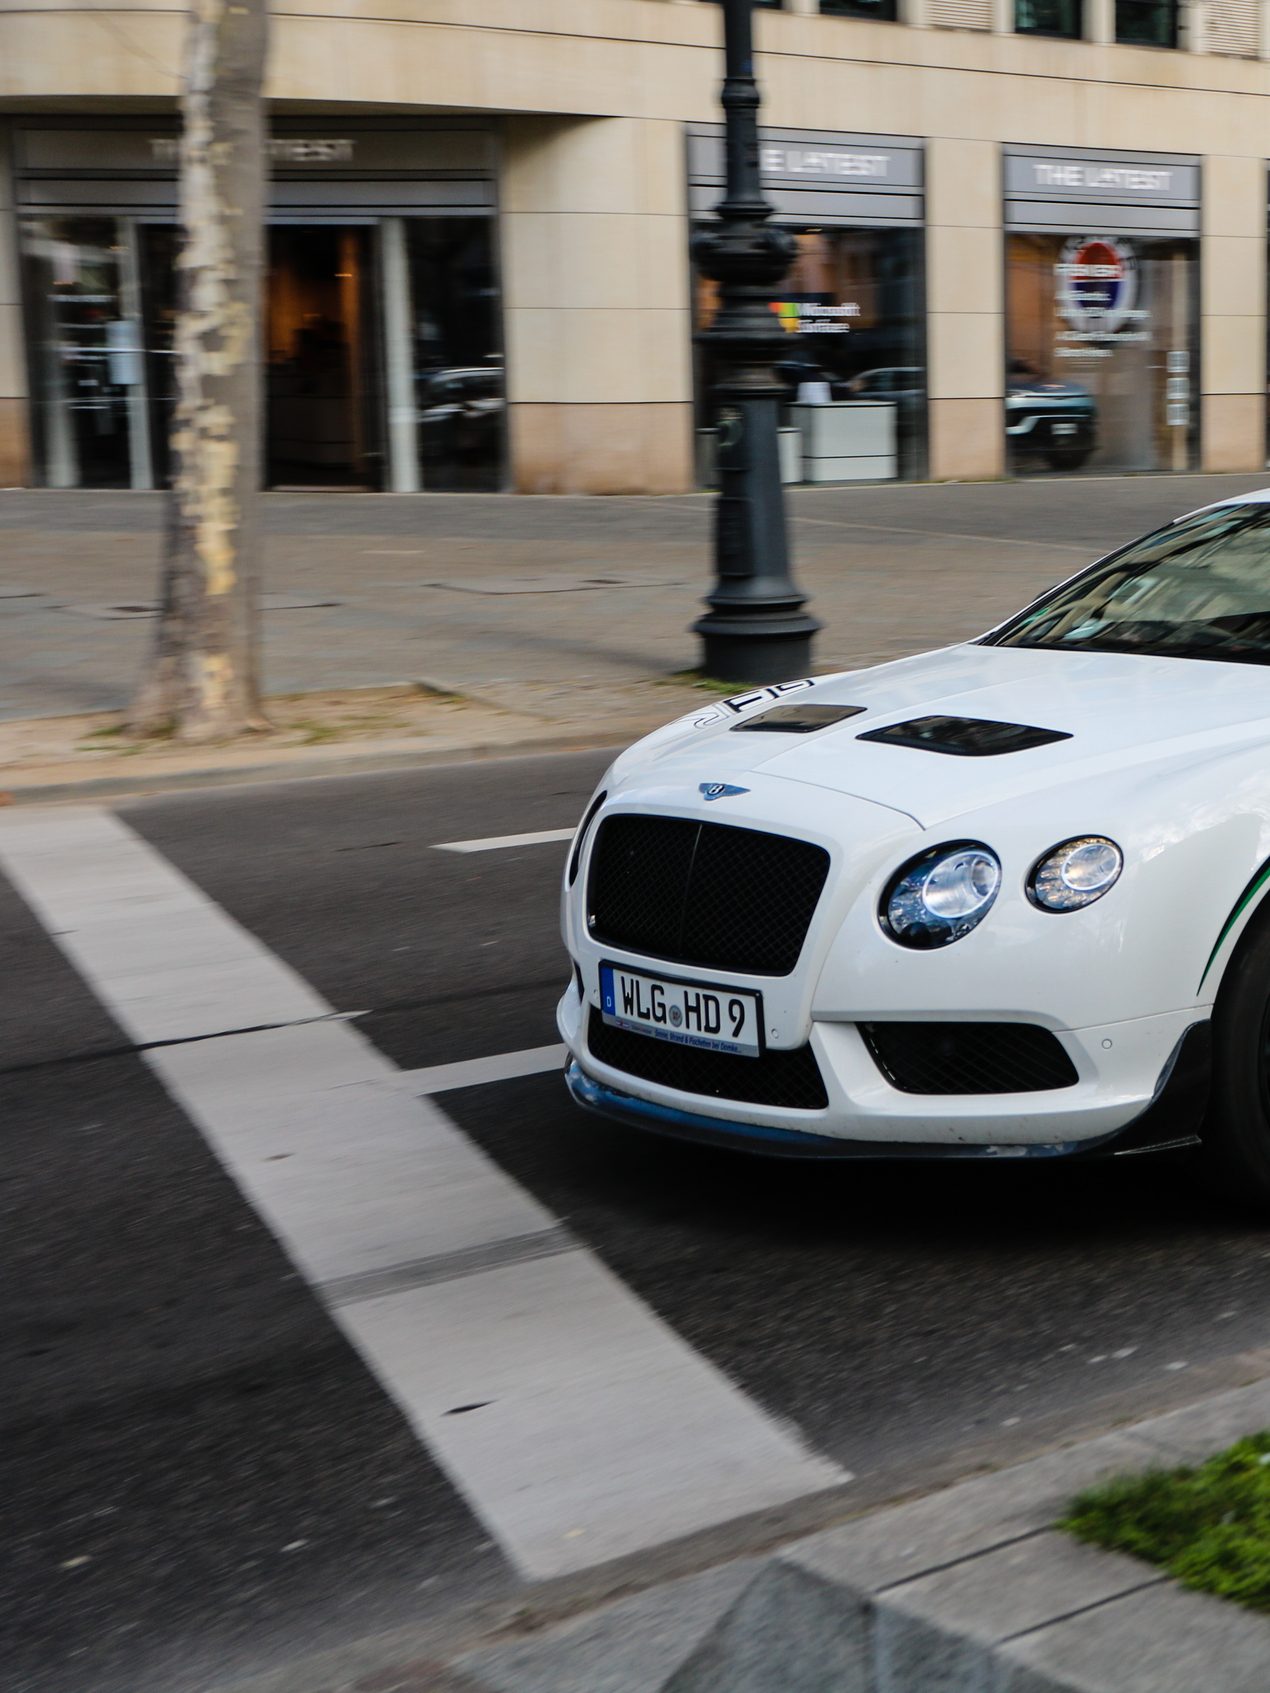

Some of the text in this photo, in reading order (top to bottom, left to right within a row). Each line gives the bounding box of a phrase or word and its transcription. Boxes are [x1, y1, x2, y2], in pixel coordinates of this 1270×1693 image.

[1032, 164, 1173, 191] THE LATEST
[606, 996, 612, 1008] D
[621, 976, 745, 1038] WLG HD 9
